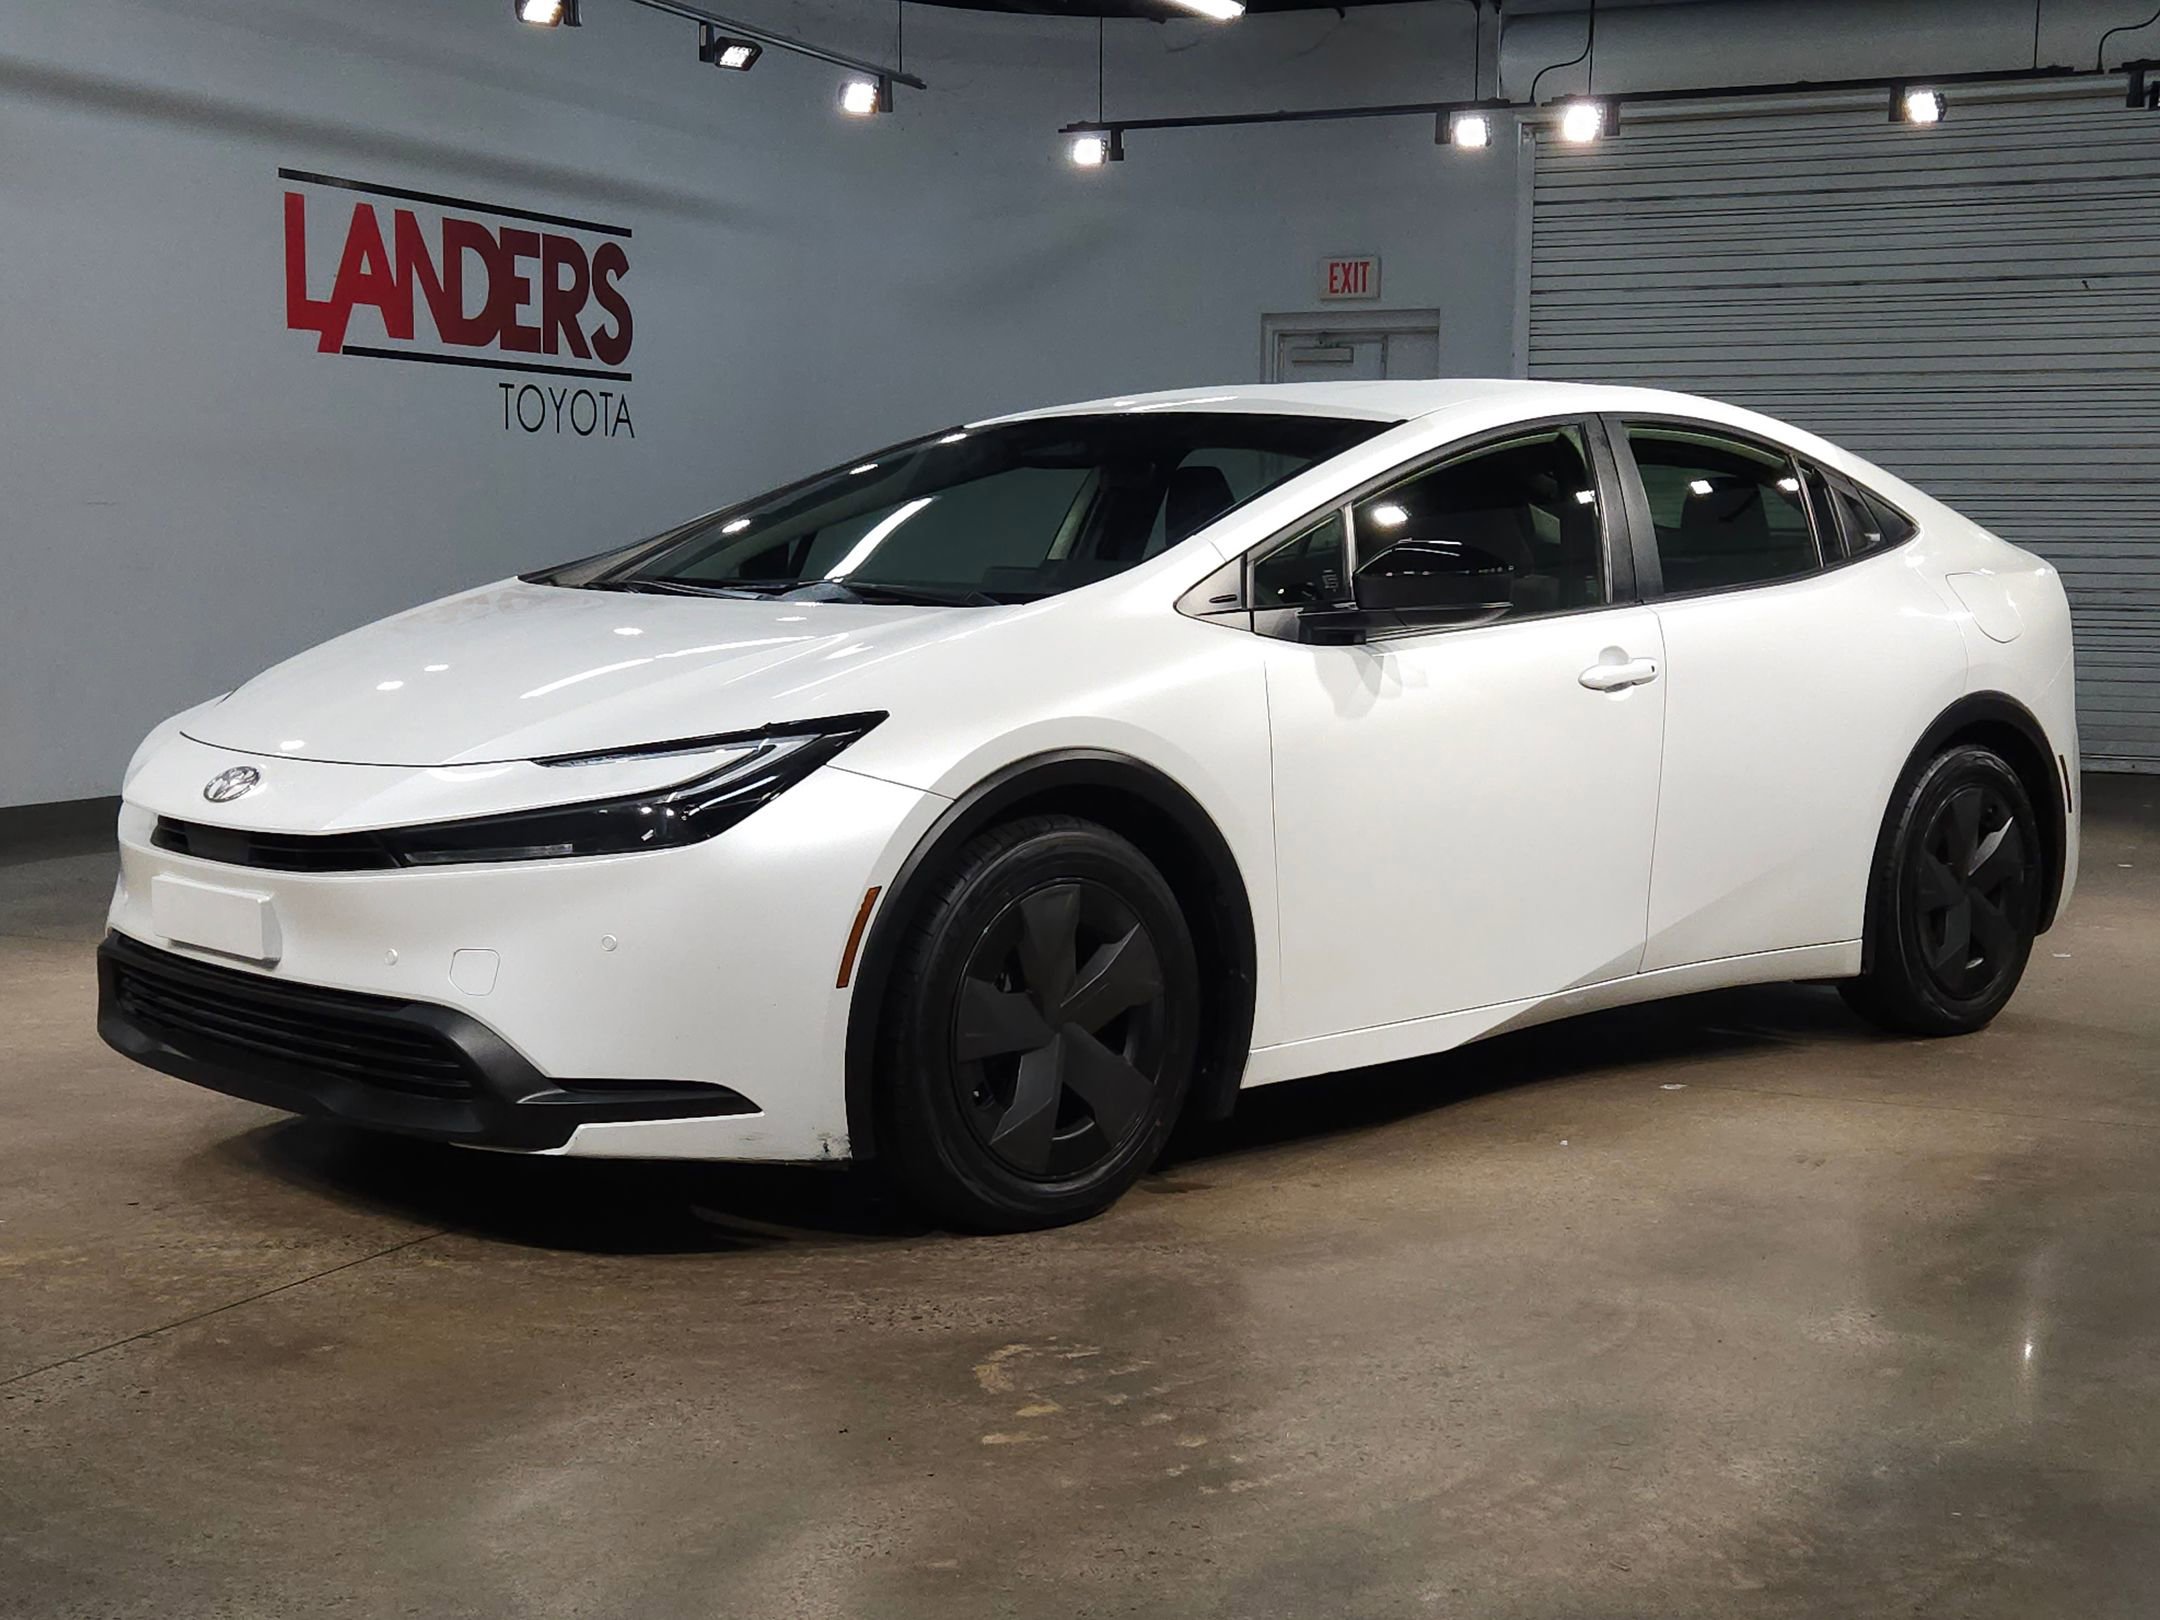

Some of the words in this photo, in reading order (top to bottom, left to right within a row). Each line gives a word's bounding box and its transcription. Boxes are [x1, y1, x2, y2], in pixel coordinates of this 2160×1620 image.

[284, 191, 633, 366] LANDERS
[1329, 262, 1369, 294] EXIT
[499, 382, 635, 438] TOYOTA
